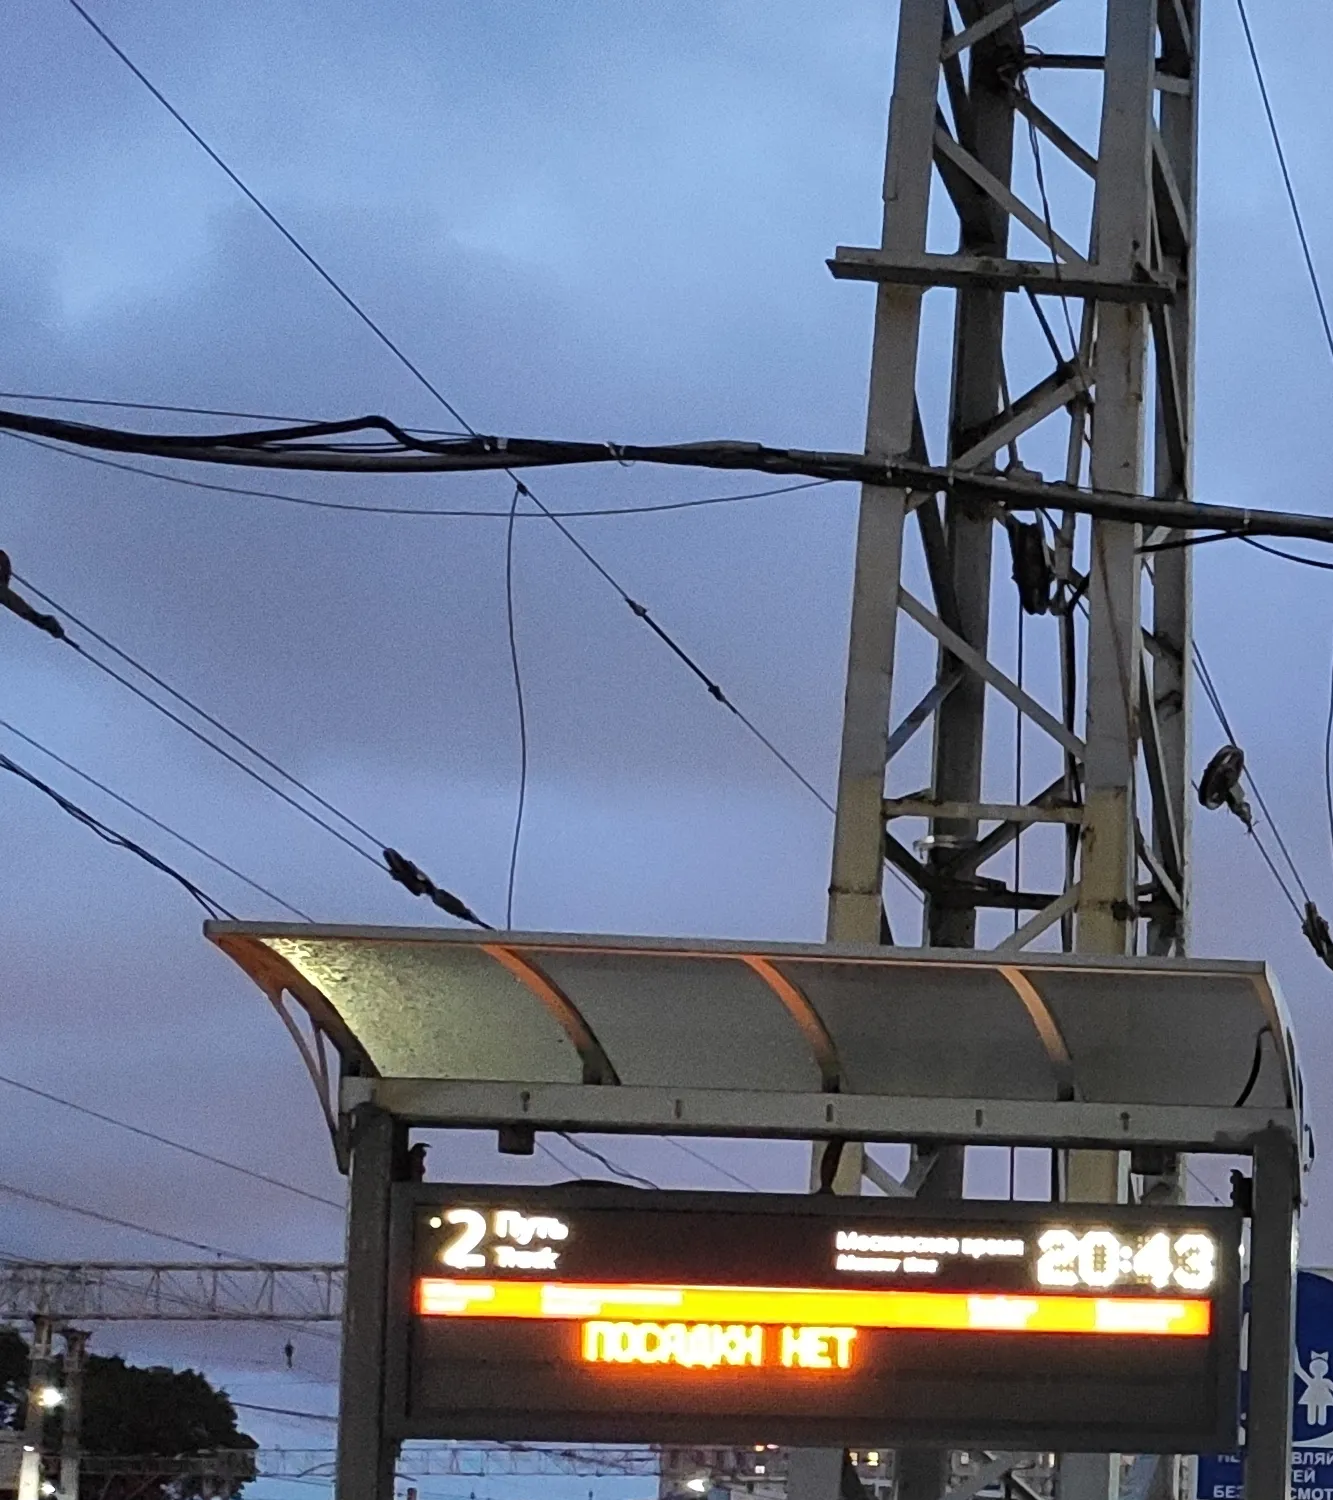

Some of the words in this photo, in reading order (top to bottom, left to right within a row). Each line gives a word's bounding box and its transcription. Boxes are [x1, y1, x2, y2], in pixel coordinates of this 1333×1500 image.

[442, 1209, 487, 1269] 2
[494, 1210, 569, 1245] Путь
[1037, 1229, 1214, 1289] 20:43
[781, 1325, 858, 1369] НЕТ
